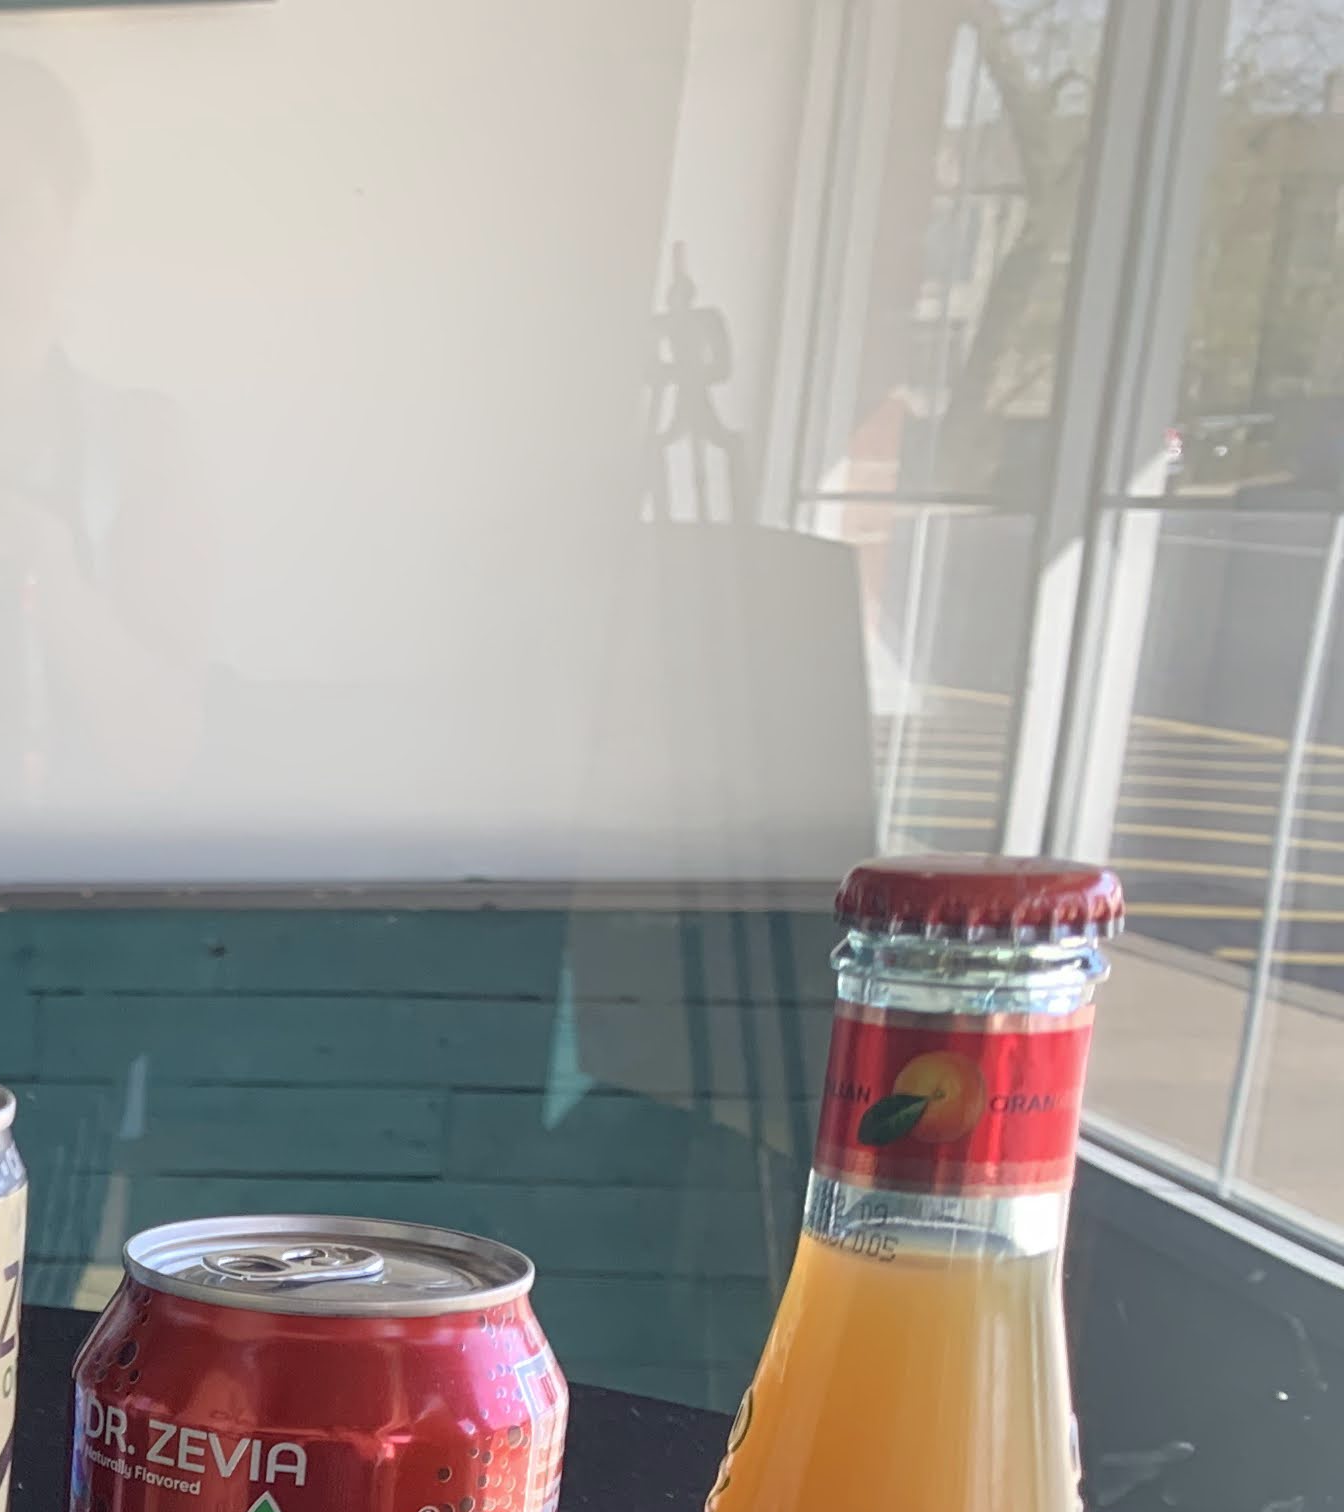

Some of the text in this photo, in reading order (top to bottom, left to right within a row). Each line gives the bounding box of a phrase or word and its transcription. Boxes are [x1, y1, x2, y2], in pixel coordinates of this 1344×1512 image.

[84, 1446, 201, 1495] Naturally Flavored
[85, 1395, 307, 1486] DR. ZEVIA
